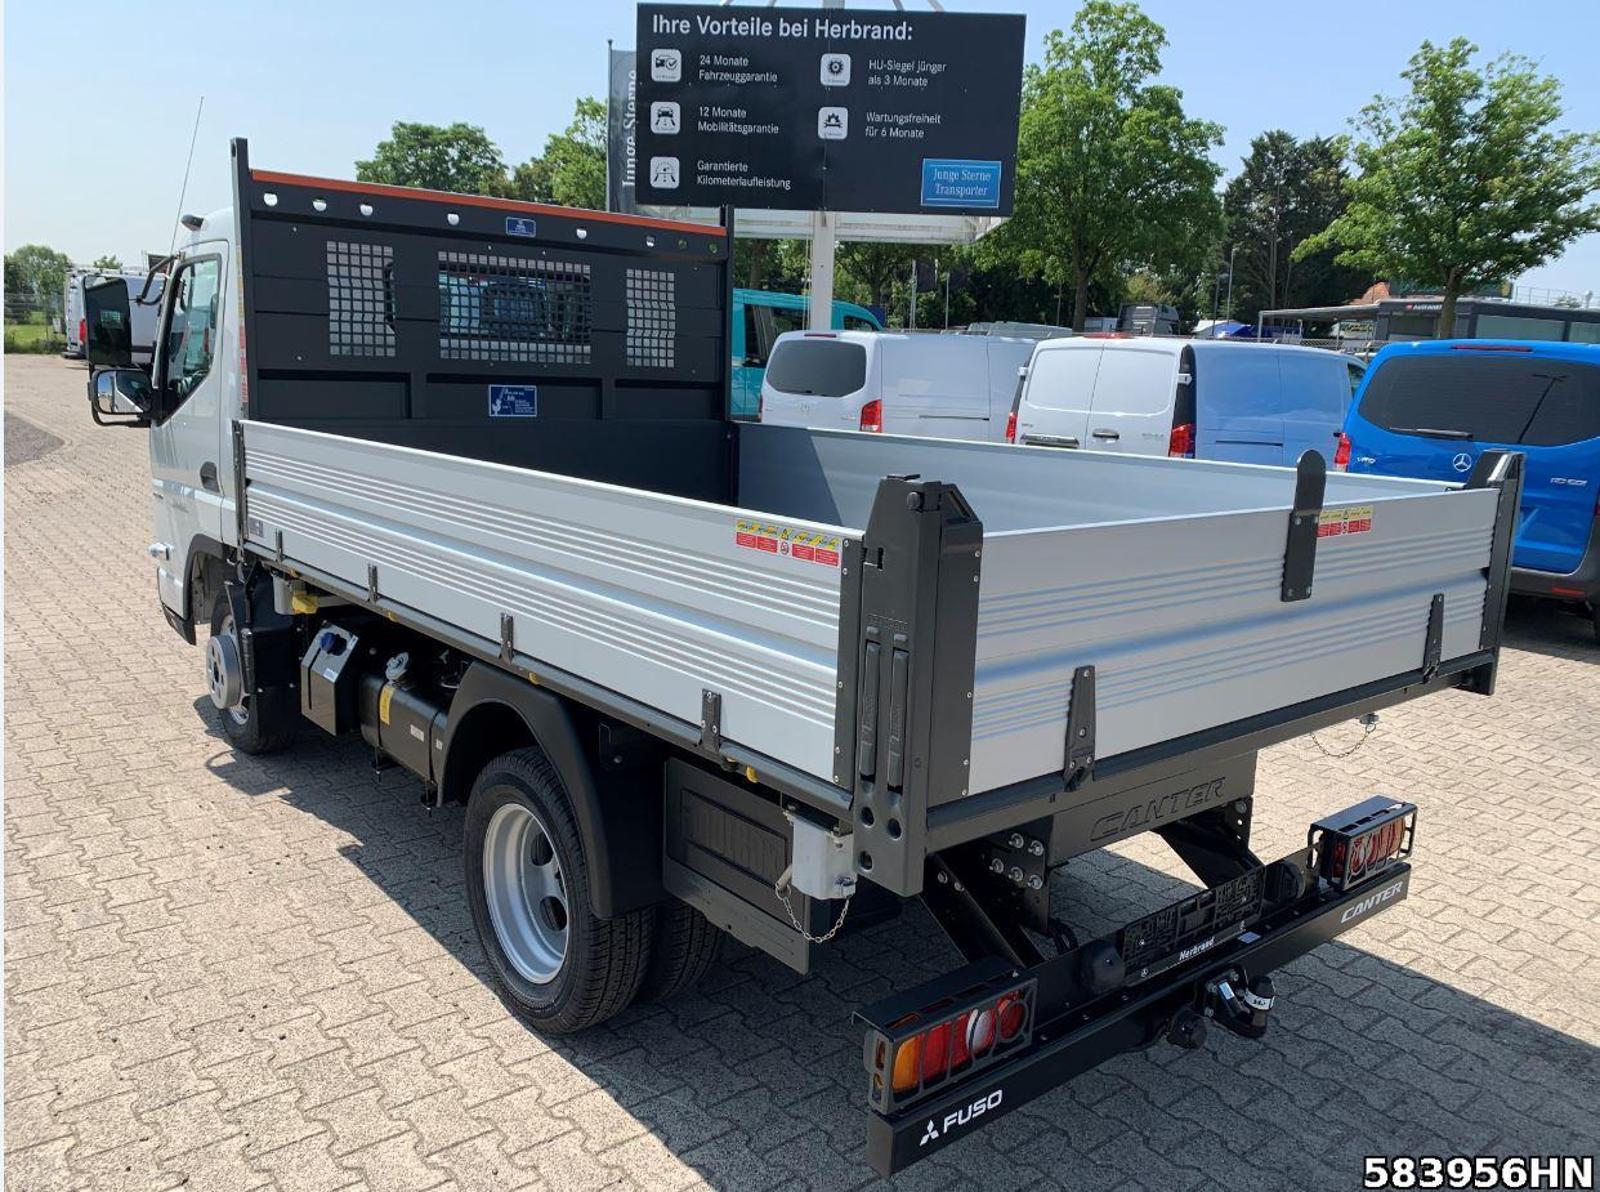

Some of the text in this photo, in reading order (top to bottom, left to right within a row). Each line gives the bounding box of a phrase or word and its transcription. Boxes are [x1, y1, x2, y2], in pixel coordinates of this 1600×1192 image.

[653, 14, 913, 41] Ihre Vorteile bei Herbrand:
[700, 55, 749, 67] 24 Monate
[868, 59, 947, 75] HU-Siegel jünger
[699, 70, 778, 84] Fahrzeuggarantie
[868, 75, 929, 87] als 3 Monate
[699, 106, 747, 118] 12 Monate
[866, 111, 942, 125] Wartungsfreiheit
[697, 121, 779, 135] Mobilitätsgarantie
[865, 126, 925, 139] für 6 Monate
[697, 160, 749, 173] Garantierte
[932, 167, 992, 183] Junge Sterne
[696, 175, 792, 191] Kilometerlaufleistung
[934, 183, 989, 198] Transporter
[1090, 776, 1227, 842] CANTER
[1341, 881, 1404, 924] CANTER
[943, 1089, 1003, 1134] FUSO
